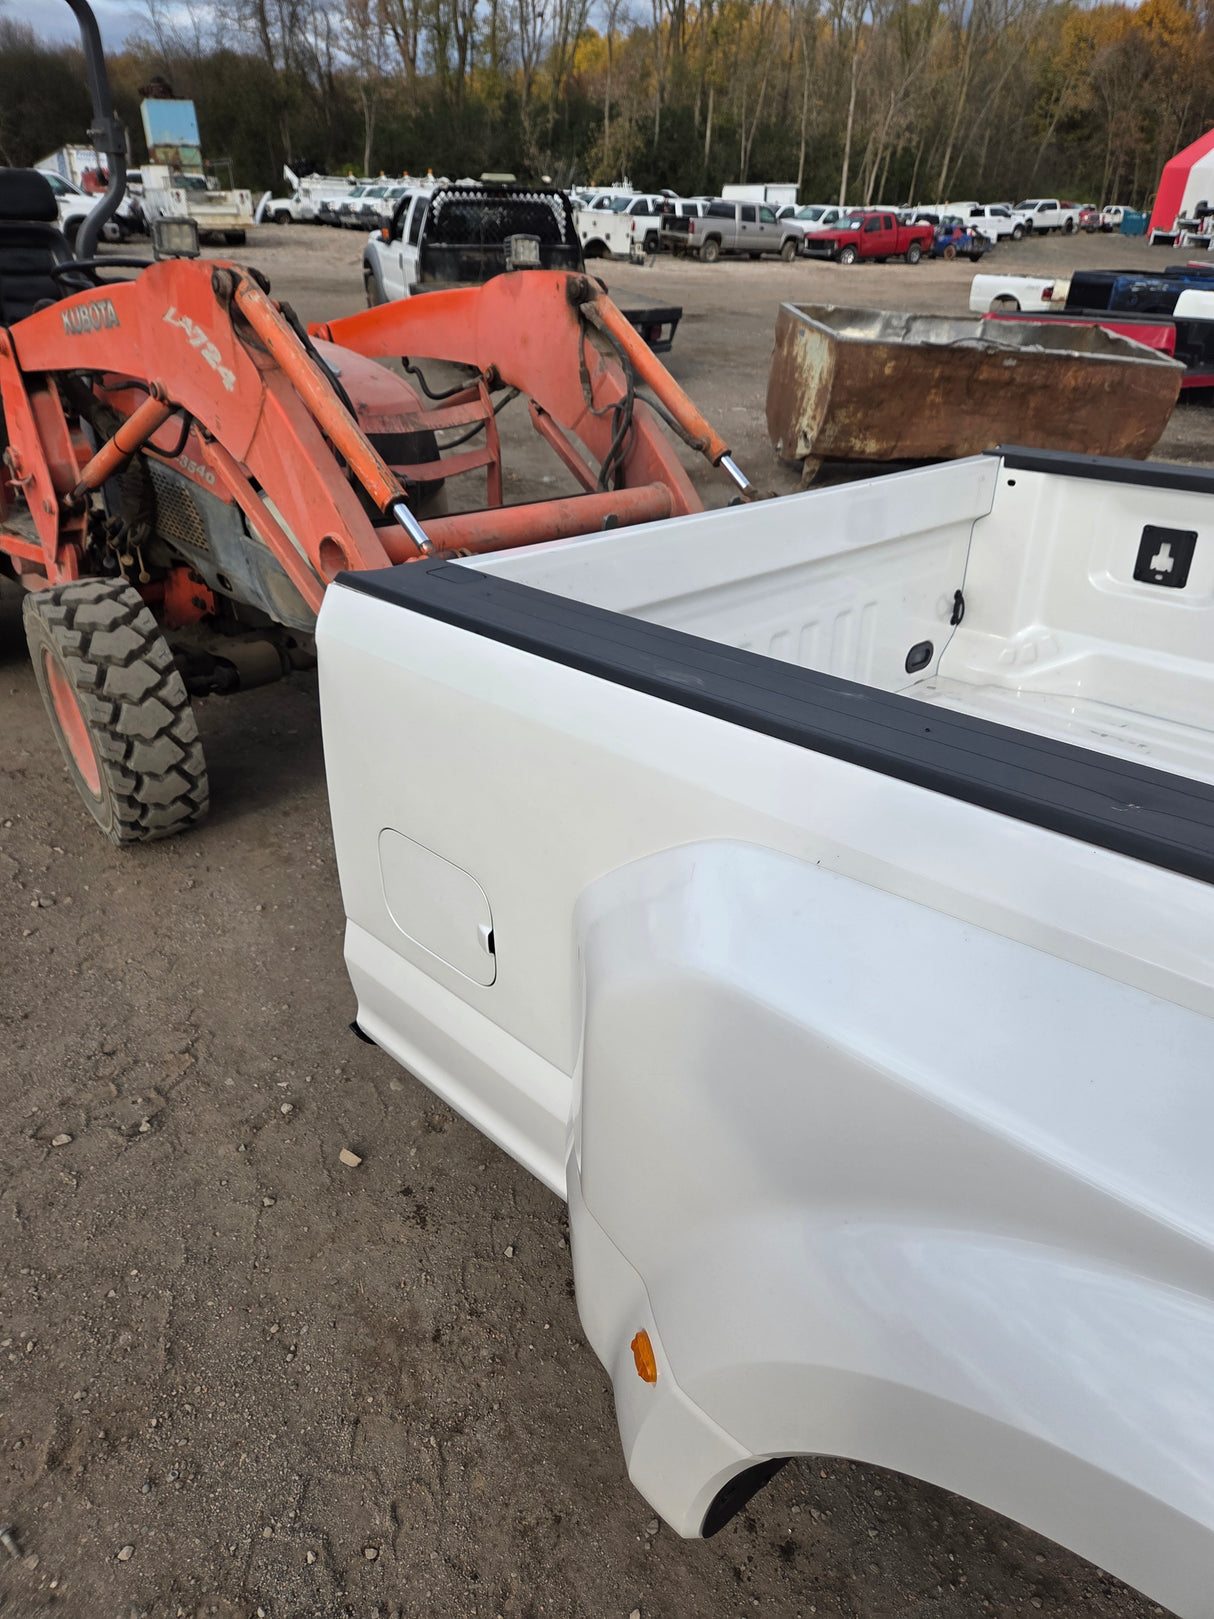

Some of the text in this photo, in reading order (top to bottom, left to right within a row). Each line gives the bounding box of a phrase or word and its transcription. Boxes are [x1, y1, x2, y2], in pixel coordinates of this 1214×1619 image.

[61, 299, 120, 335] KUBOTA
[163, 306, 236, 392] LA724
[174, 454, 216, 485] 3540
